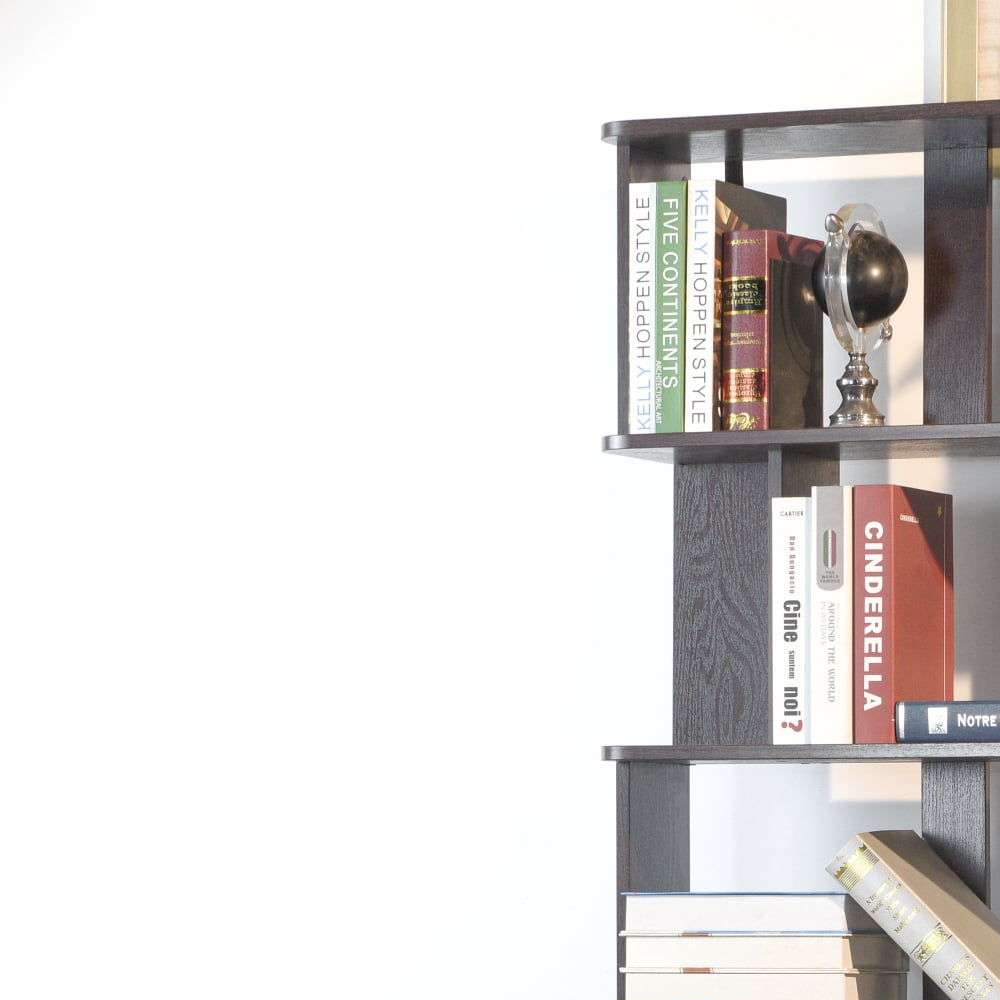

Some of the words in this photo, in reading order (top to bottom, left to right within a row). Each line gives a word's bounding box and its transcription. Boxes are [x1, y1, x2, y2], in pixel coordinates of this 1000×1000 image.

[636, 196, 650, 263] STYLE
[662, 198, 679, 245] FIVE
[694, 189, 709, 255] KELLY
[636, 270, 651, 358] HOPPEN
[662, 251, 679, 389] CONTINENTS
[692, 262, 708, 350] HOPPEN
[637, 365, 651, 431] KELLY
[691, 357, 707, 424] STYLE
[783, 599, 801, 643] Cine
[828, 602, 836, 642] AROUND
[863, 520, 884, 712] CINDERELLA
[828, 646, 836, 664] THE
[828, 668, 836, 703] WORLD
[957, 713, 998, 728] NOTRE
